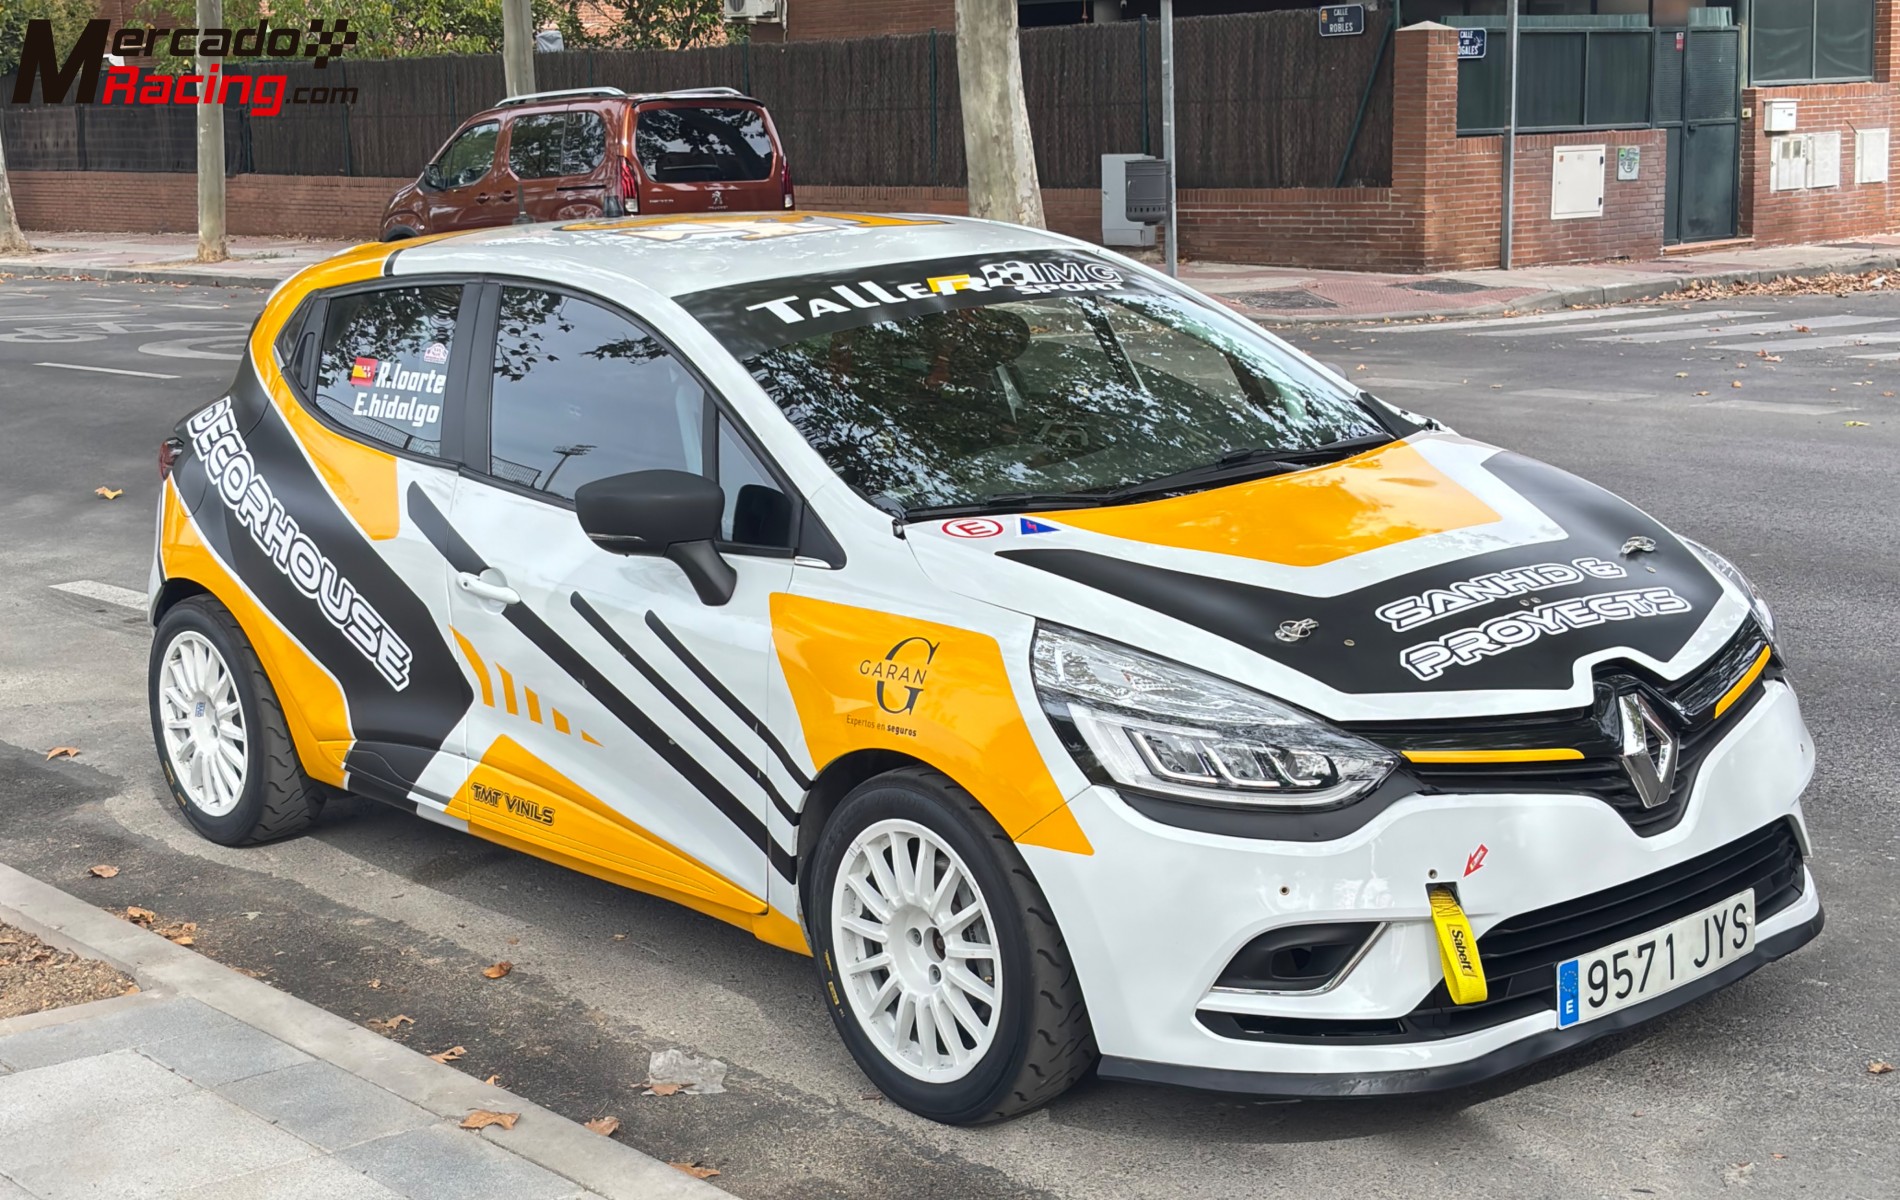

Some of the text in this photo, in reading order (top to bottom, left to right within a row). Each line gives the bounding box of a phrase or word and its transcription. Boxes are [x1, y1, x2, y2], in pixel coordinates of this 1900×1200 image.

[1333, 8, 1348, 16] CALLE
[1329, 22, 1353, 32] ROBLES
[1460, 31, 1473, 39] CALLE
[1028, 262, 1124, 282] IMG
[1019, 282, 1125, 295] SPORT
[353, 391, 440, 428] E.hidalgo
[187, 396, 412, 691] DECORHOUSE
[1375, 557, 1627, 632] SANHID &
[1400, 587, 1692, 682] PROYECTS
[859, 659, 927, 685] GARAN
[846, 714, 917, 737] Expertos en seguros
[471, 782, 555, 826] TMT VINILS
[1451, 929, 1473, 971] Sabelt
[1587, 903, 1747, 1008] 9571 JYS
[1565, 999, 1574, 1014] E
